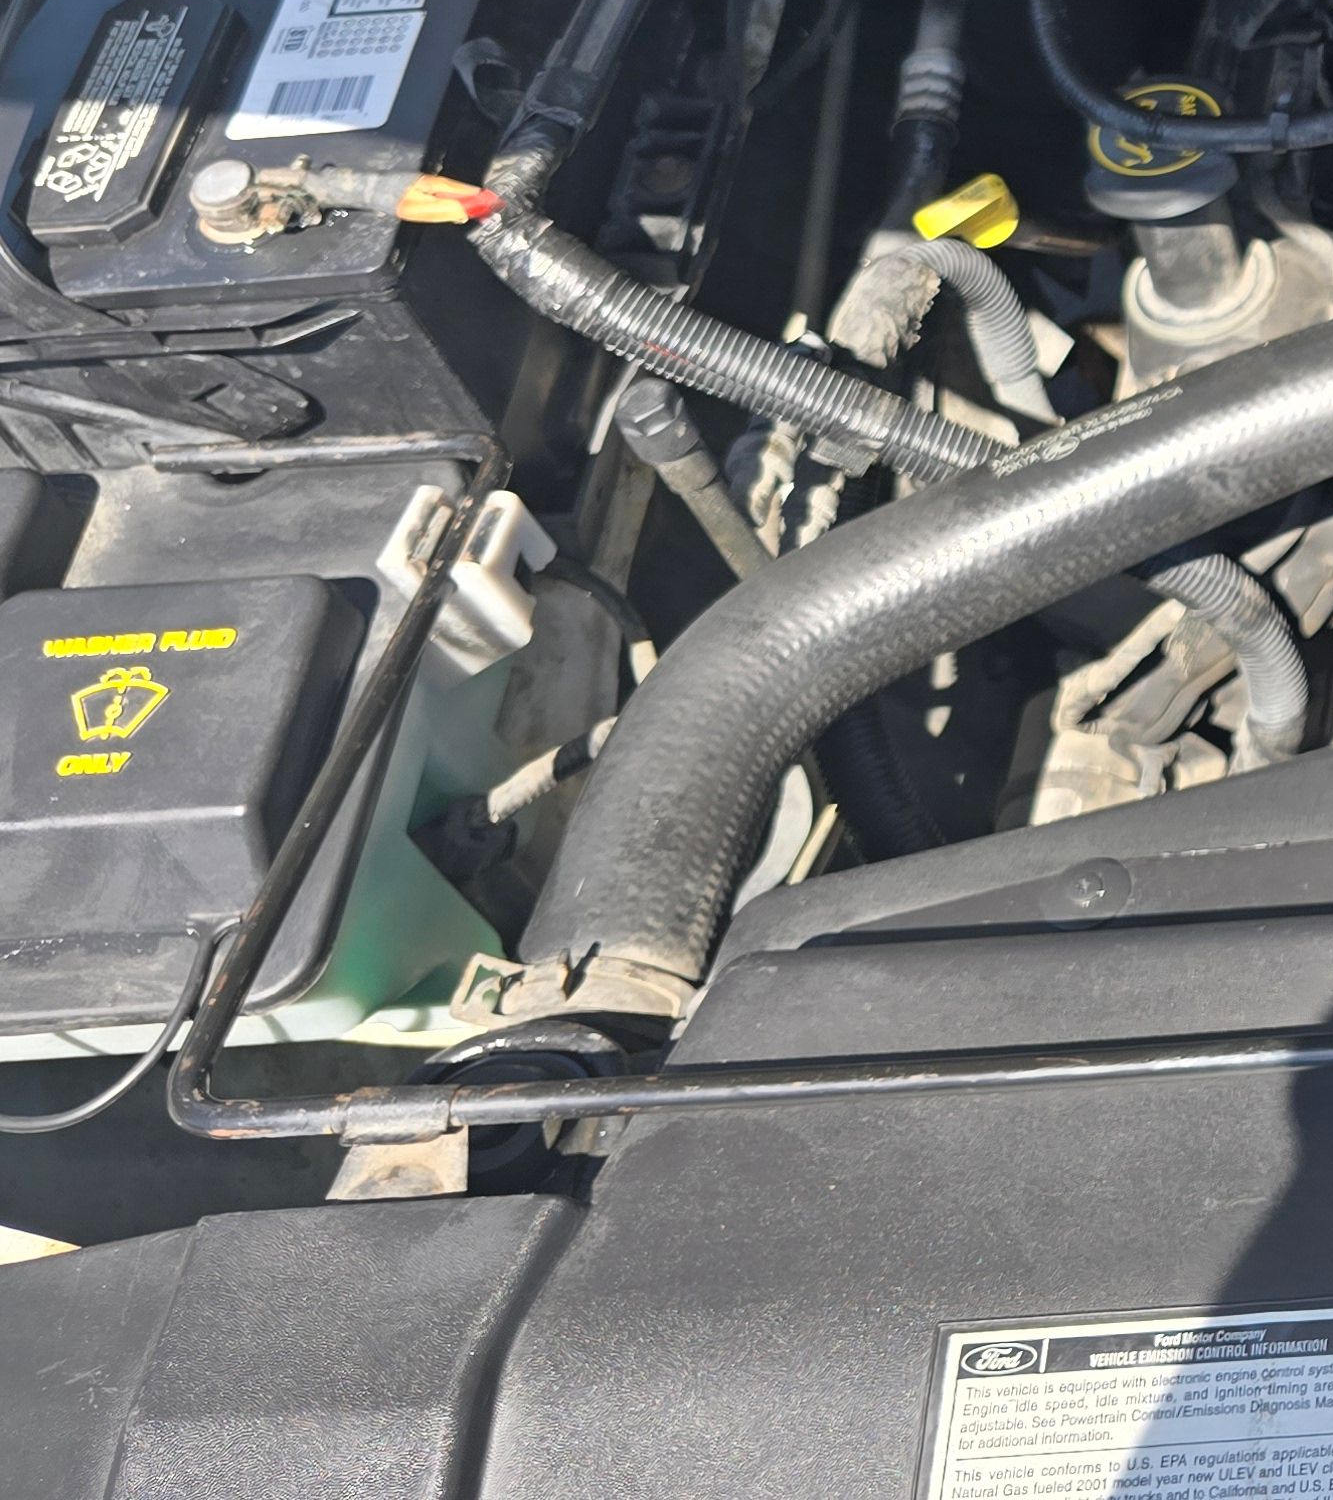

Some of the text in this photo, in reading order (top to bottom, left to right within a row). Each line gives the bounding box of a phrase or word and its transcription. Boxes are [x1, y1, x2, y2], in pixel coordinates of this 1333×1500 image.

[43, 627, 238, 658] WASHER FLUID
[56, 751, 134, 777] ONLY
[1154, 1328, 1268, 1347] Ford Motor Company
[975, 1347, 1023, 1371] Ford
[1090, 1339, 1328, 1367] VEHICLE EMISSION CONTROL INFORMATION
[966, 1387, 991, 1399] This
[996, 1384, 1039, 1396] vehicle
[1044, 1382, 1054, 1394] is
[1059, 1378, 1117, 1394] equipped
[1122, 1376, 1146, 1388] with
[1152, 1371, 1211, 1386] electronic
[1215, 1370, 1257, 1384] engine
[1261, 1365, 1305, 1379] control
[963, 1404, 1007, 1418] Engine
[1045, 1400, 1088, 1413] speed,
[1125, 1393, 1177, 1406] mixture,
[1184, 1389, 1208, 1400] and
[1268, 1382, 1307, 1397] timing
[960, 1421, 1027, 1435] adjustable.
[1032, 1416, 1055, 1428] See
[1061, 1412, 1127, 1426] Powertrain
[1131, 1402, 1246, 1421] Control/Emissions
[1250, 1399, 1310, 1414] Diagnosis
[958, 1430, 1113, 1450] for additional information.
[956, 1471, 982, 1482] This
[989, 1467, 1034, 1480] vehicle
[1041, 1464, 1102, 1477] conforms
[1109, 1462, 1121, 1472] to
[1127, 1458, 1154, 1471] U.S.
[1160, 1455, 1187, 1468] EPA
[1193, 1450, 1266, 1468] regulations
[952, 1485, 998, 1499] Natural
[1003, 1483, 1028, 1496] Gas
[1033, 1480, 1072, 1494] fueled
[1076, 1478, 1107, 1492] 2001
[1112, 1474, 1150, 1489] model
[1156, 1473, 1183, 1489] year
[1187, 1472, 1214, 1484] new
[1218, 1467, 1256, 1481] ULEV
[1259, 1465, 1283, 1478] and
[1167, 1487, 1190, 1500] and
[1194, 1487, 1205, 1500] to
[1209, 1483, 1268, 1499] California
[1272, 1481, 1295, 1494] and
[1299, 1479, 1325, 1493] U.S.
